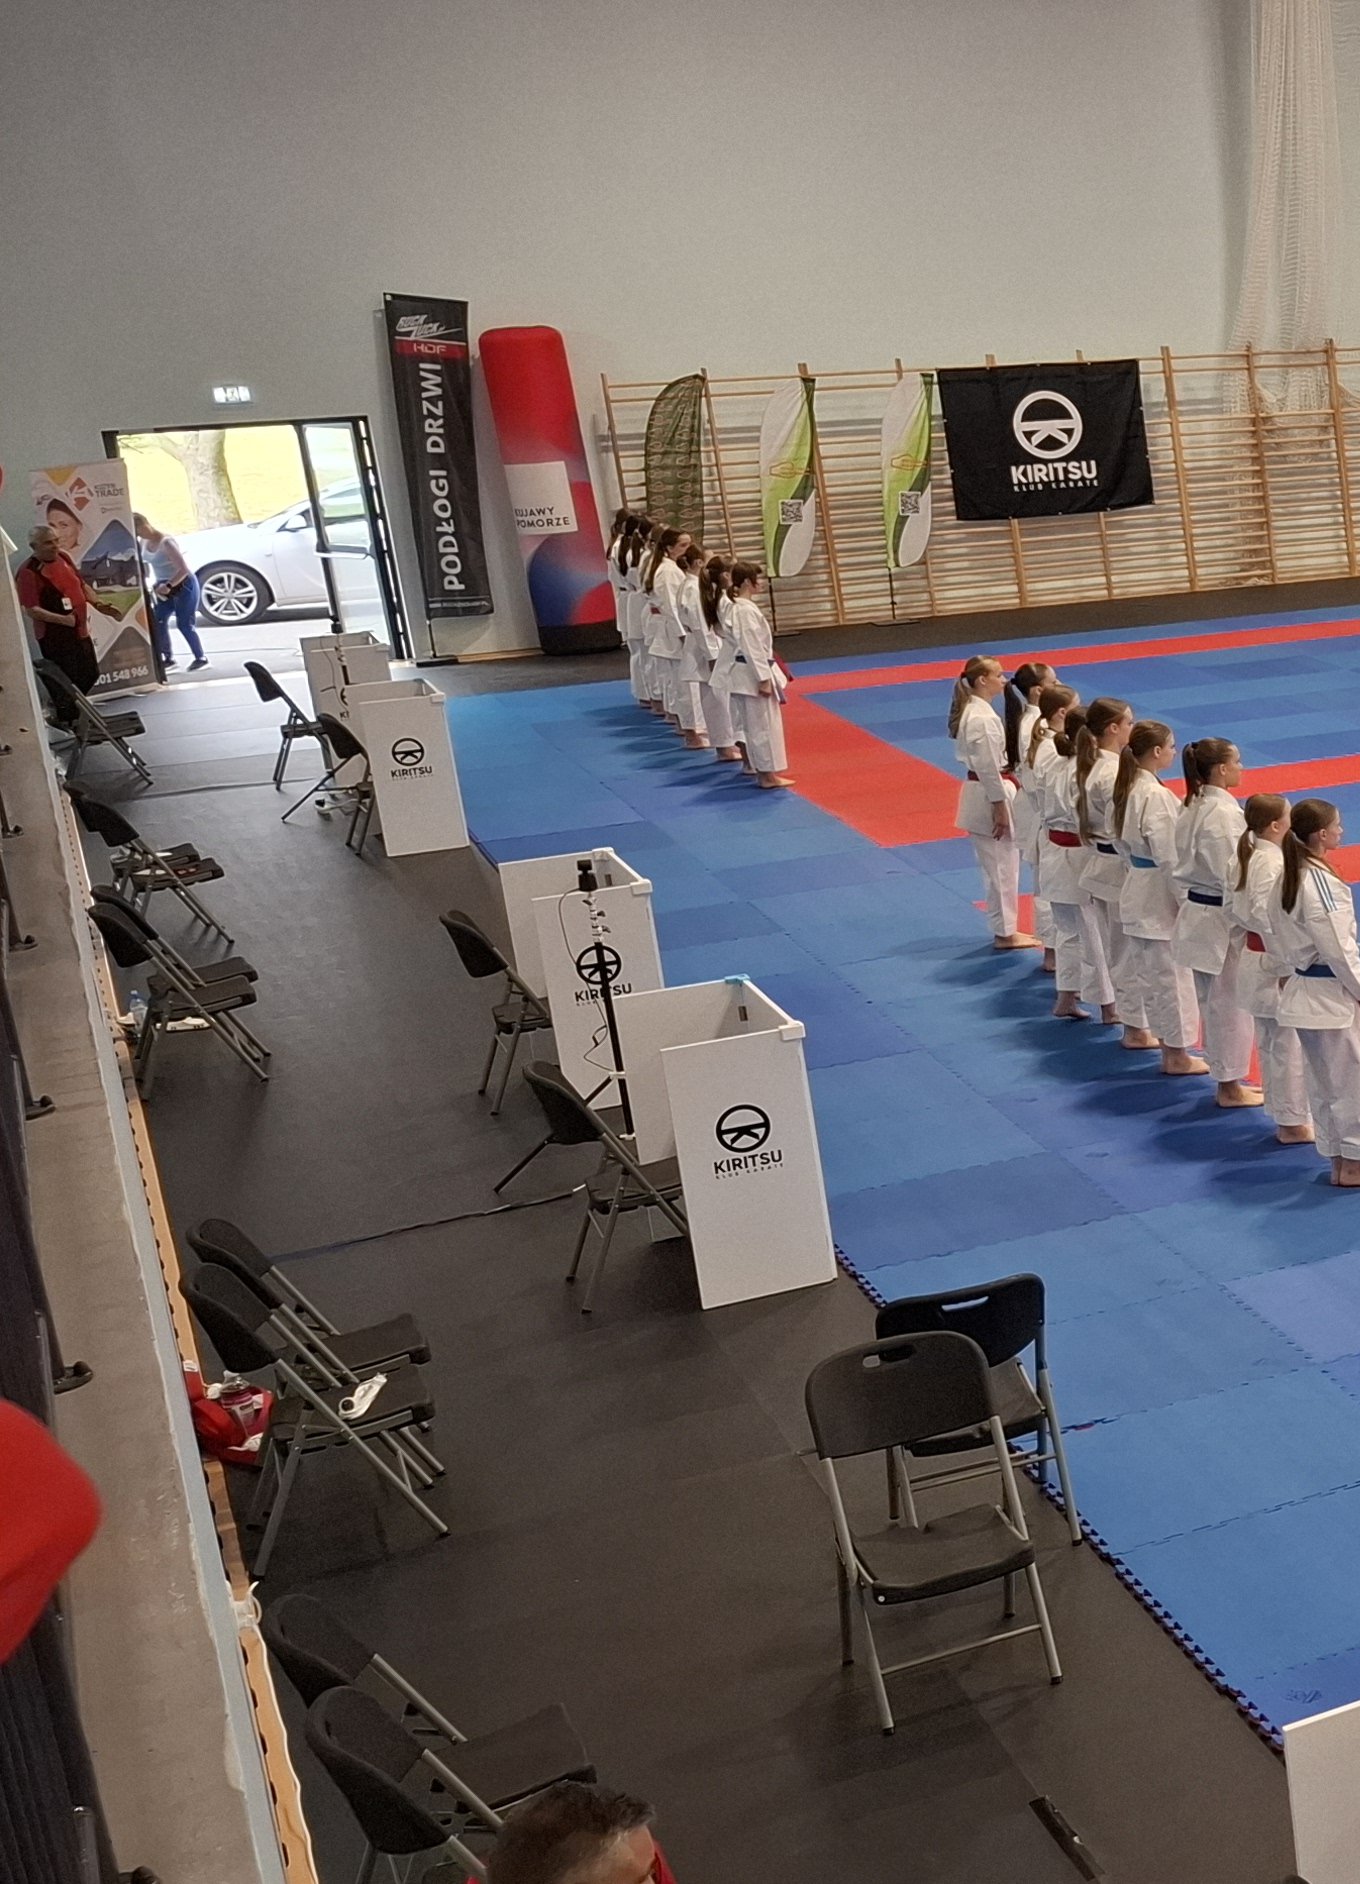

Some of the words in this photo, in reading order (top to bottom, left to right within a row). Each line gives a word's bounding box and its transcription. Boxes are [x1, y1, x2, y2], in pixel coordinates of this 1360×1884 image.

[419, 362, 446, 454] DRZWI
[1011, 460, 1098, 484] KIRITSU
[1014, 483, 1043, 492] KLUB
[1051, 479, 1098, 489] KARATE
[429, 469, 466, 592] PODŁOGI
[390, 766, 433, 778] KIRITSU
[575, 982, 632, 1002] KIRISU
[714, 1149, 782, 1175] KIRITSU
